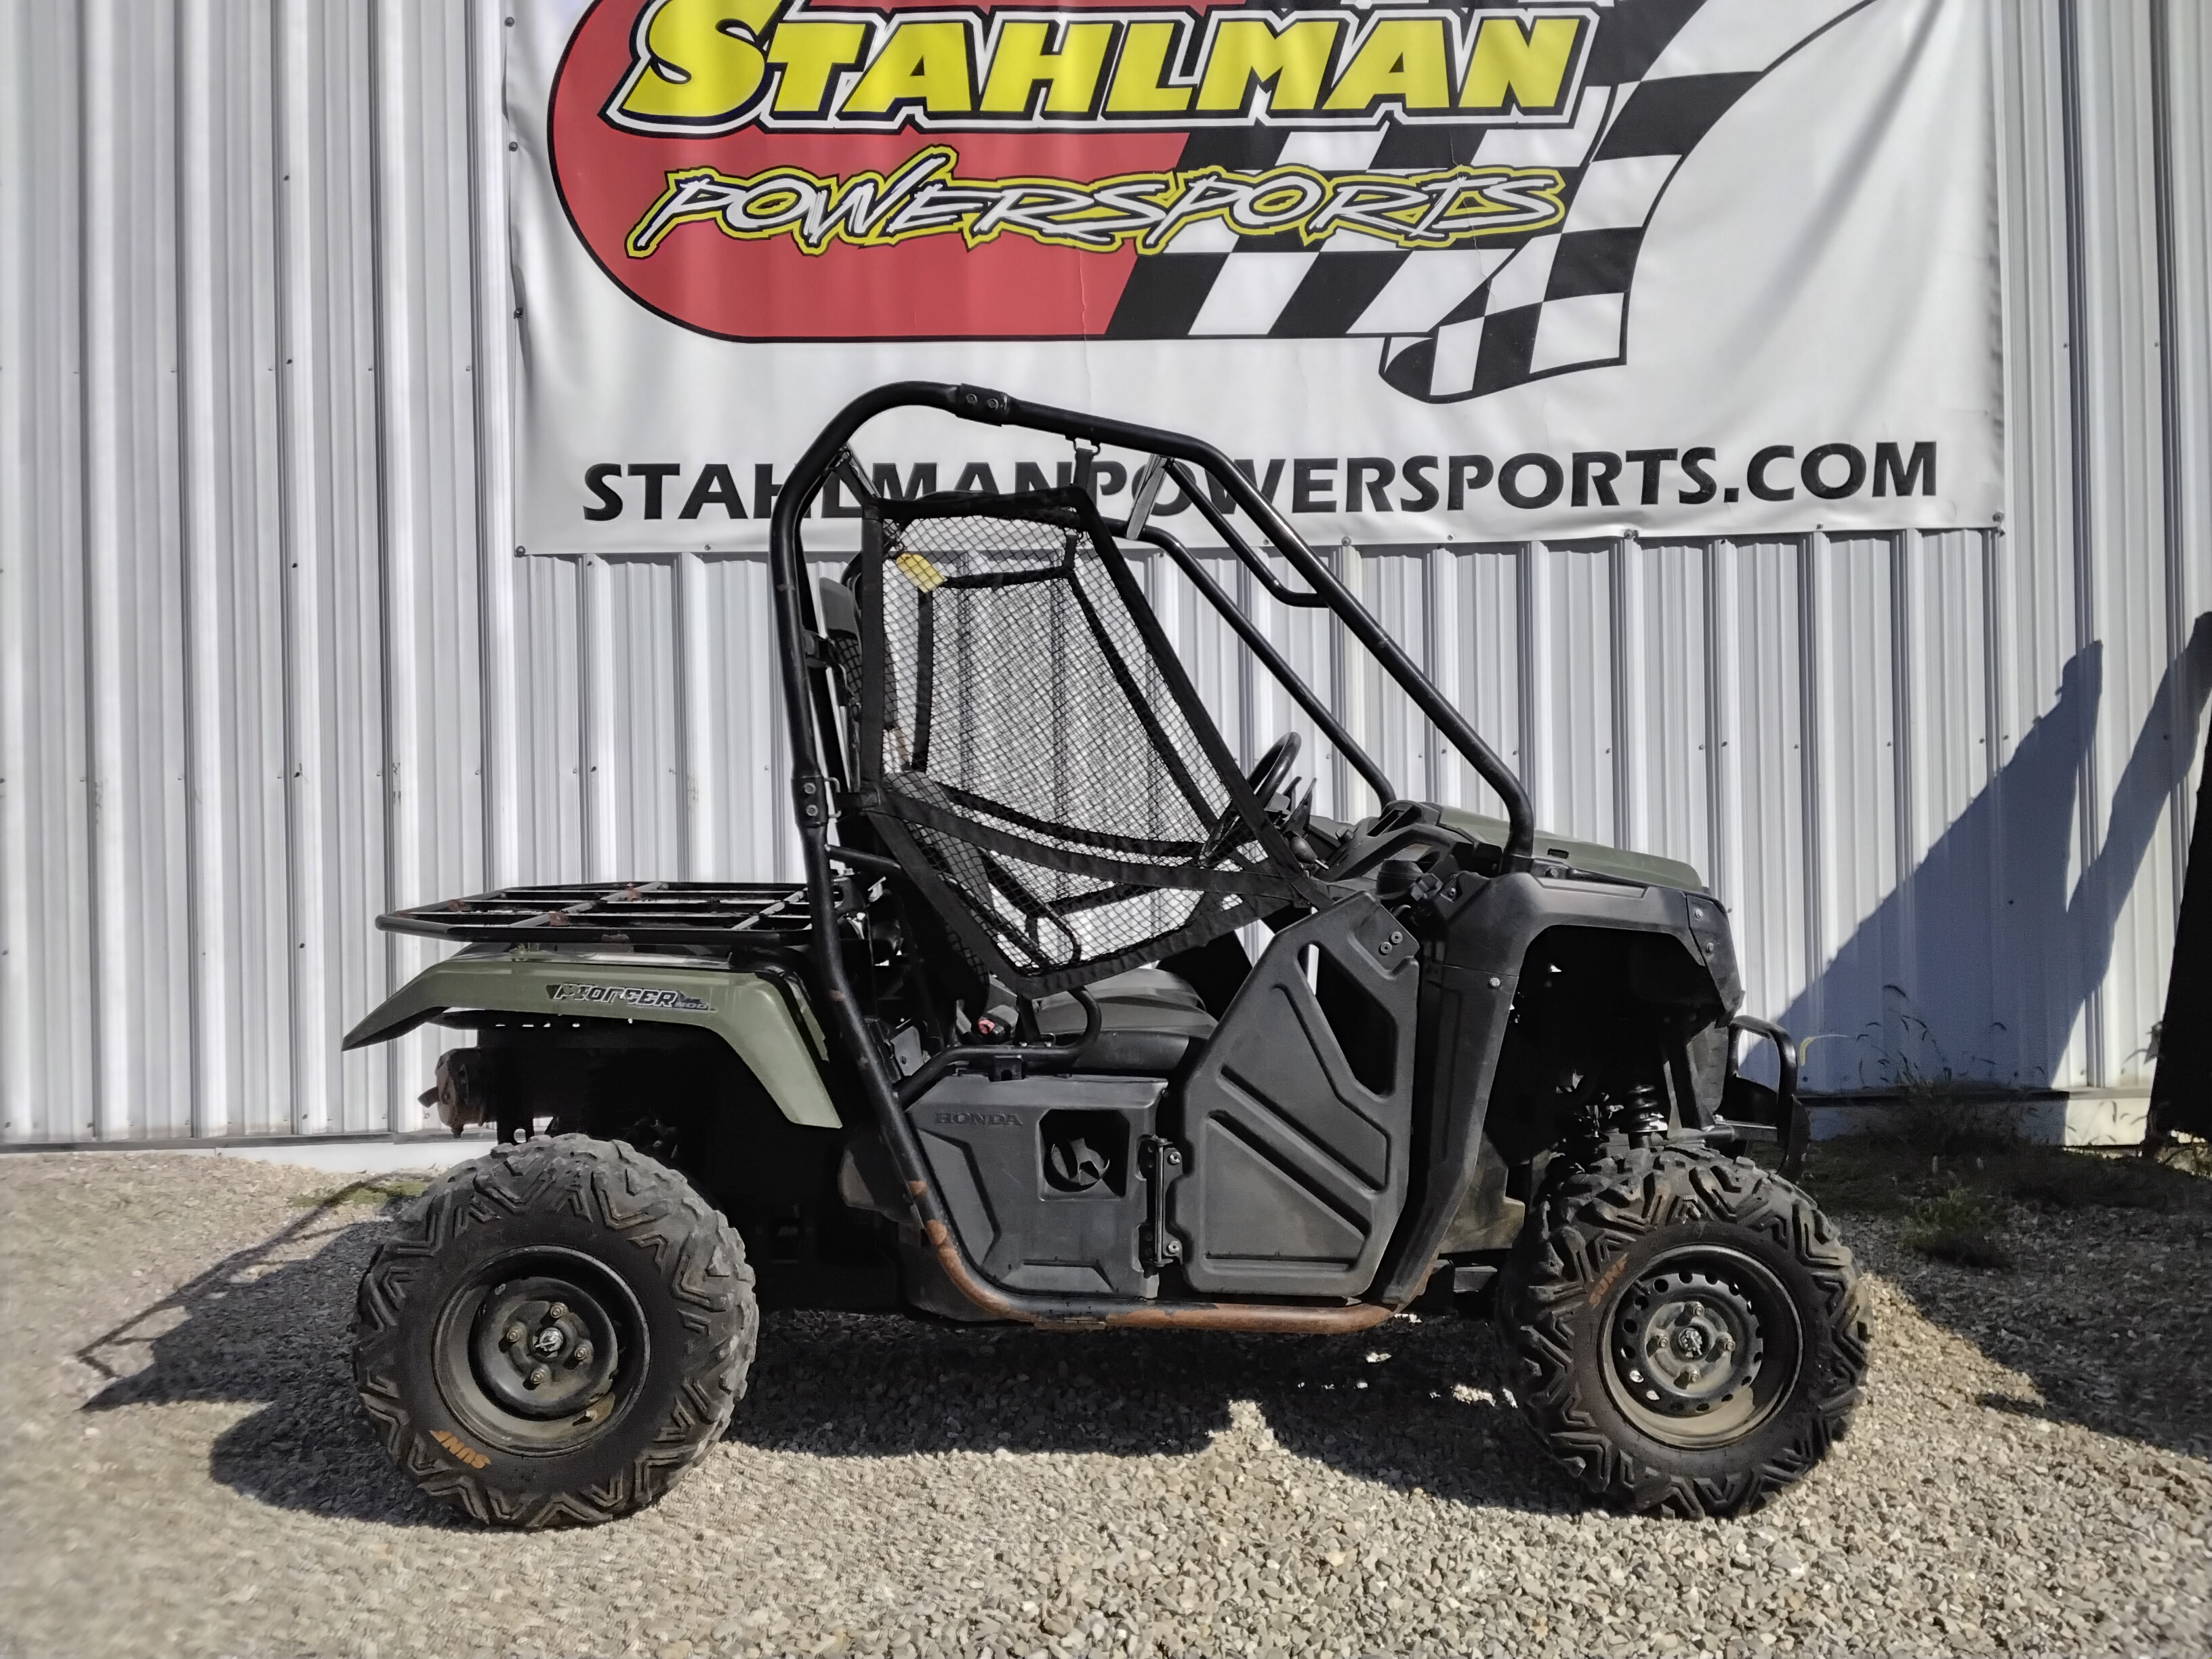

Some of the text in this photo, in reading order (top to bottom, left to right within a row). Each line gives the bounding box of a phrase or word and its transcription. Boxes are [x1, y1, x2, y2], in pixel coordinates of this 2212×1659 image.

[621, 0, 1582, 119] STAHLMAN
[630, 150, 1559, 253] POWERSPORTS
[934, 1112, 1024, 1126] HONDA
